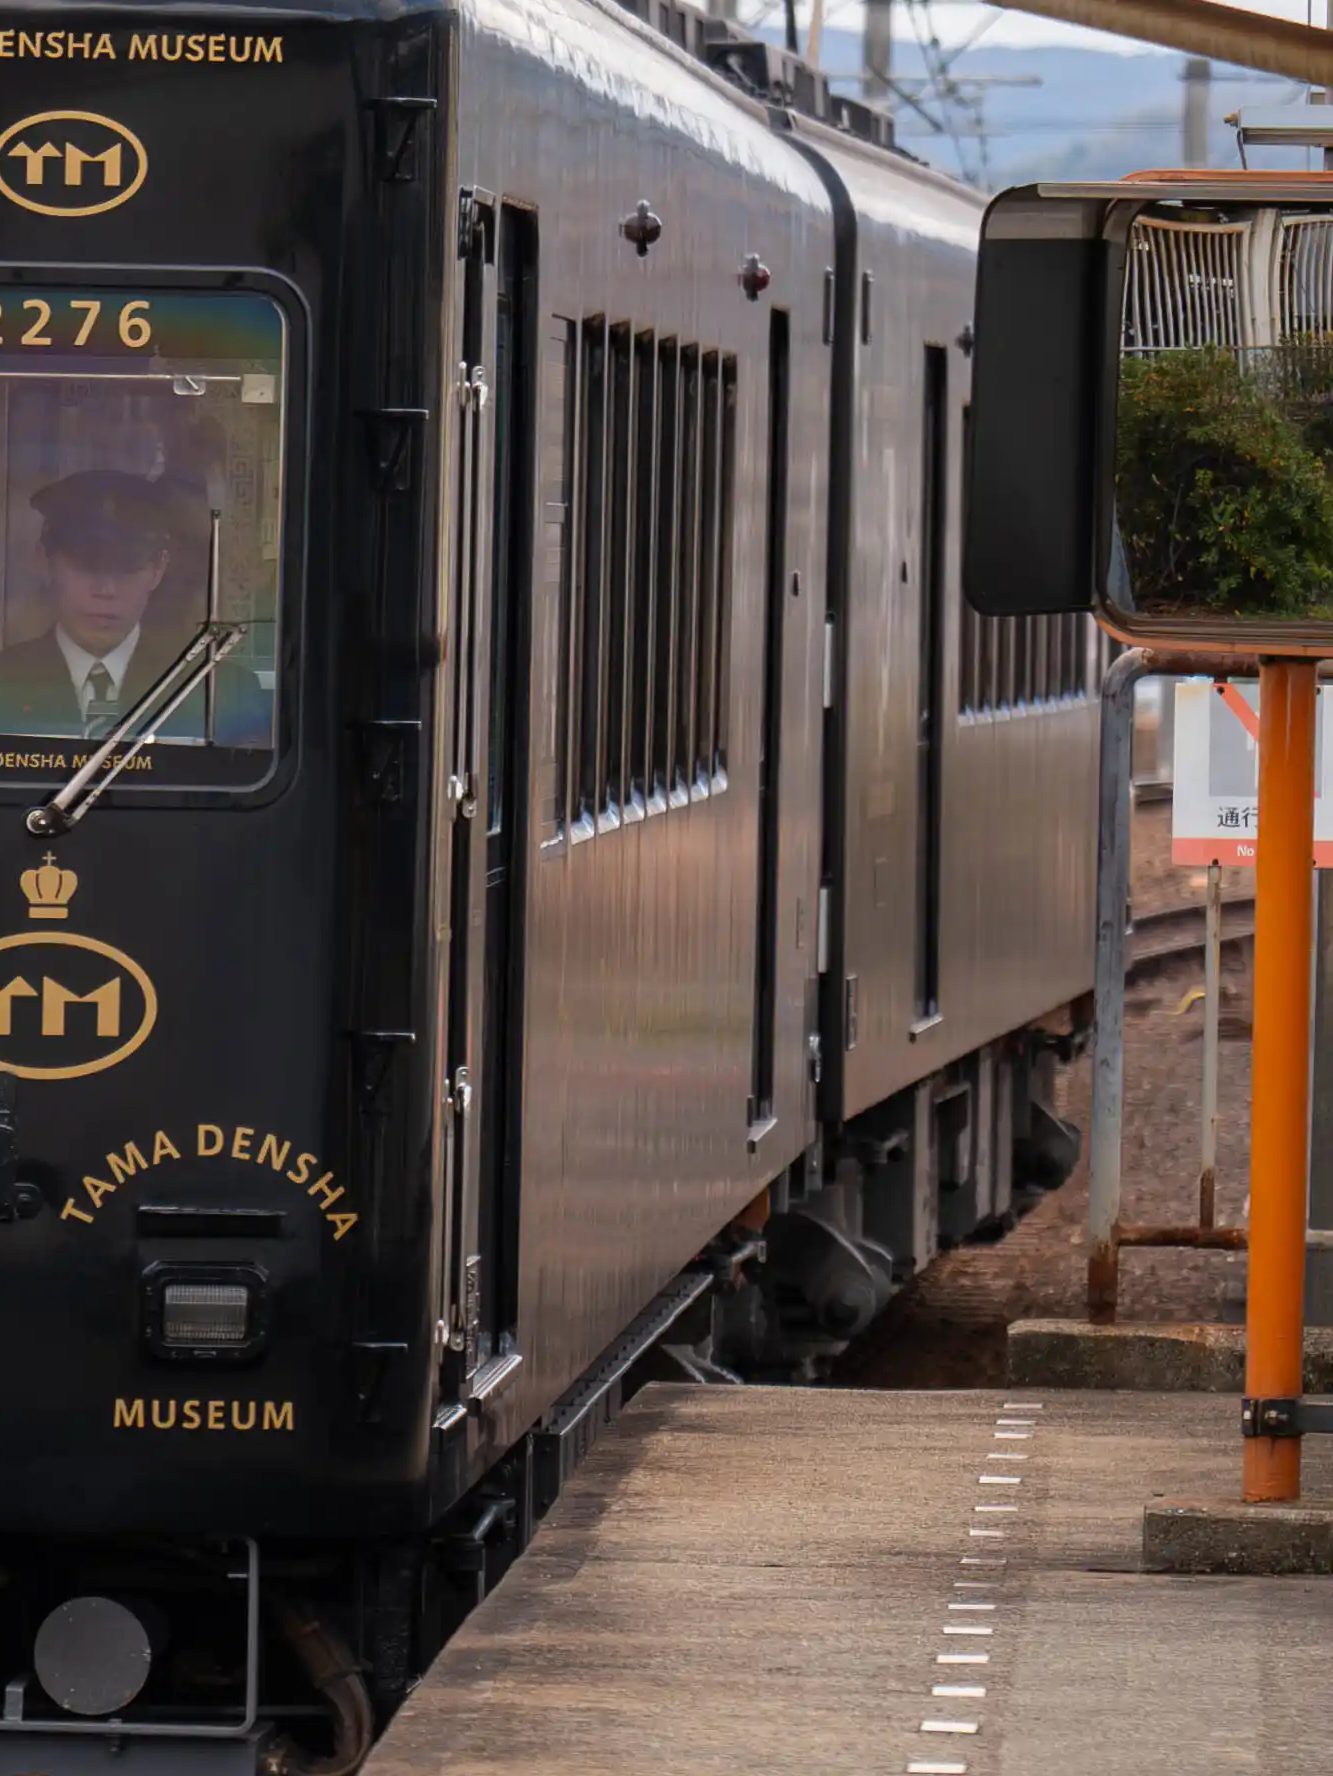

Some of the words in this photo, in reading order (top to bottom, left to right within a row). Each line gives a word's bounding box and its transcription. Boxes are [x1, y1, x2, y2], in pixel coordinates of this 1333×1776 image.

[128, 34, 283, 63] MUSEUM
[72, 754, 153, 770] MSEUM
[1237, 845, 1254, 857] No
[60, 1131, 182, 1224] TAMA
[197, 1123, 358, 1241] DENSHA
[113, 1398, 295, 1431] MUSEUM
